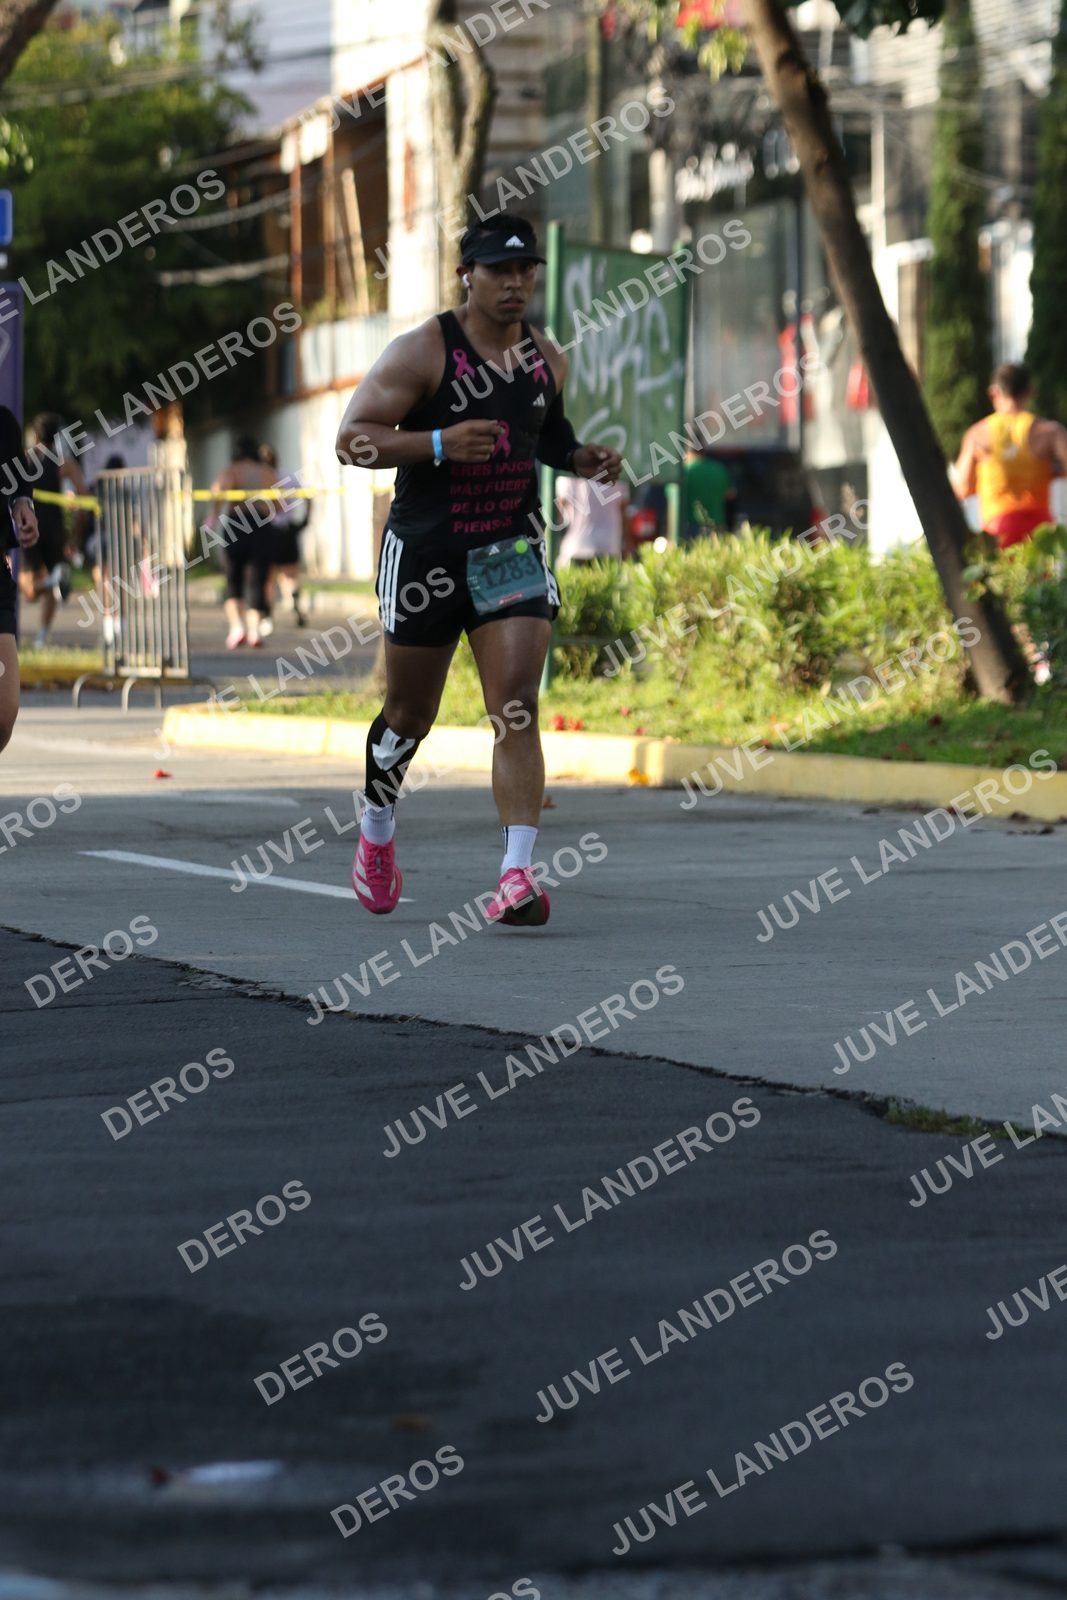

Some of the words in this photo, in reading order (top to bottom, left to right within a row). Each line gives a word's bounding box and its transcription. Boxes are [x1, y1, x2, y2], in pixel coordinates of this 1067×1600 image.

[450, 501, 470, 514] DE
[475, 499, 496, 514] LO
[482, 555, 537, 590] 1283
